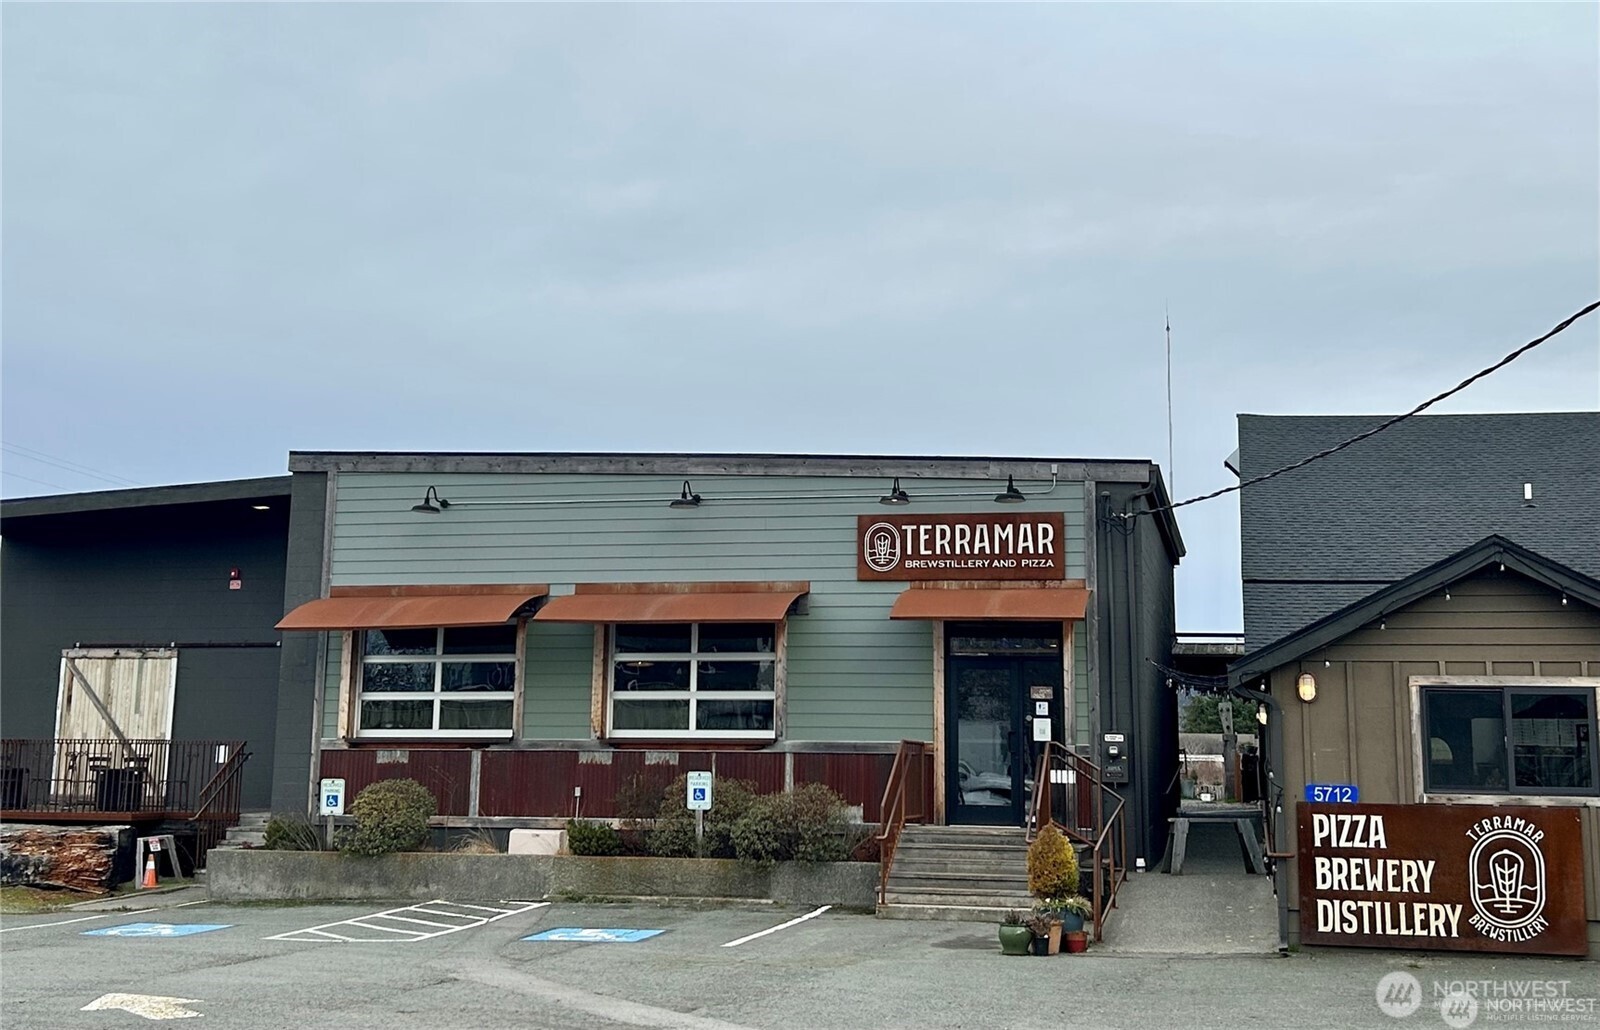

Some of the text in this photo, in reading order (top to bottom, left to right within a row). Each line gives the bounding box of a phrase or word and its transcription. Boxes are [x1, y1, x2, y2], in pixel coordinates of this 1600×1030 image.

[901, 523, 1055, 555] TERRAMAR
[905, 559, 1054, 568] BREWSTILLERY AND PIZZA
[1313, 787, 1352, 803] 5712
[1312, 813, 1387, 849] PIZZA
[1465, 815, 1544, 844] TERRAMAR
[1314, 857, 1436, 893] BREWERY
[1316, 898, 1463, 938] DISTILLERY
[1468, 914, 1550, 942] BREWSTILLERY
